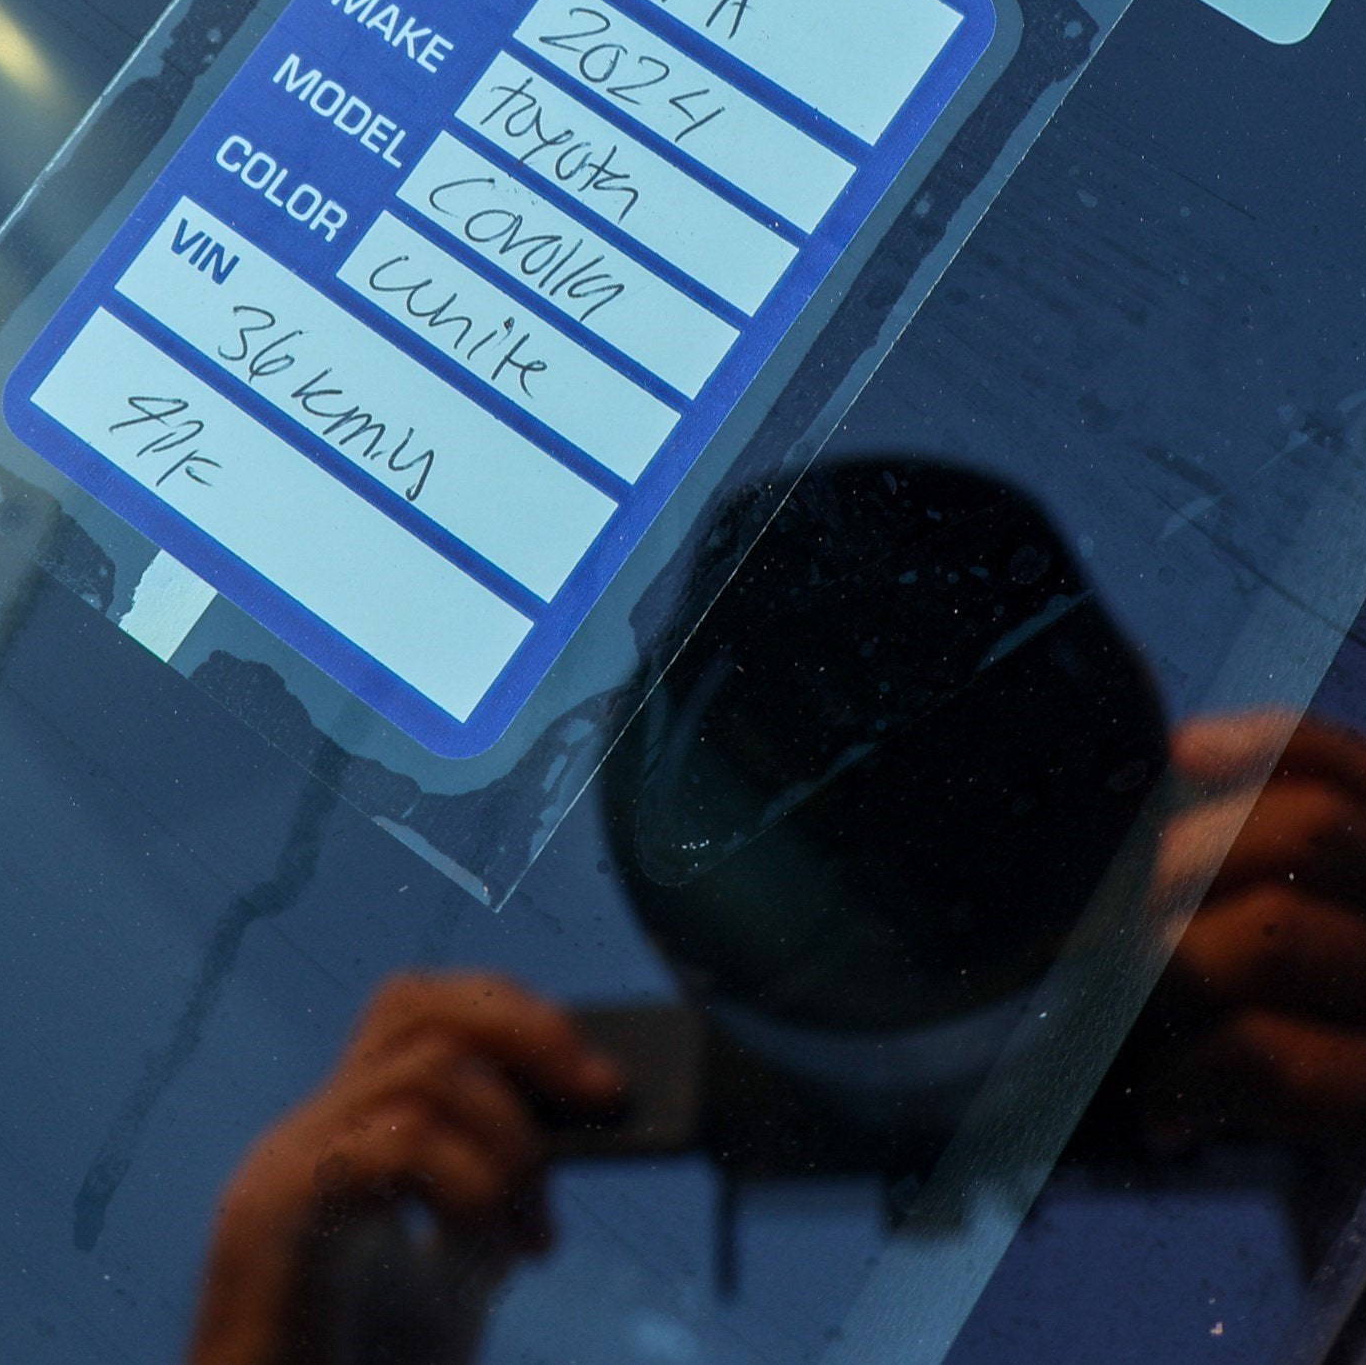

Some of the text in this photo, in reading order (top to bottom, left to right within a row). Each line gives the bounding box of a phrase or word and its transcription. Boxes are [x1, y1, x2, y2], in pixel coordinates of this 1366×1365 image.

[272, 52, 407, 169] MODEL
[538, 7, 726, 143] 2024
[215, 134, 349, 243] COLOR
[170, 217, 240, 286] VIN
[217, 305, 305, 383] 36
